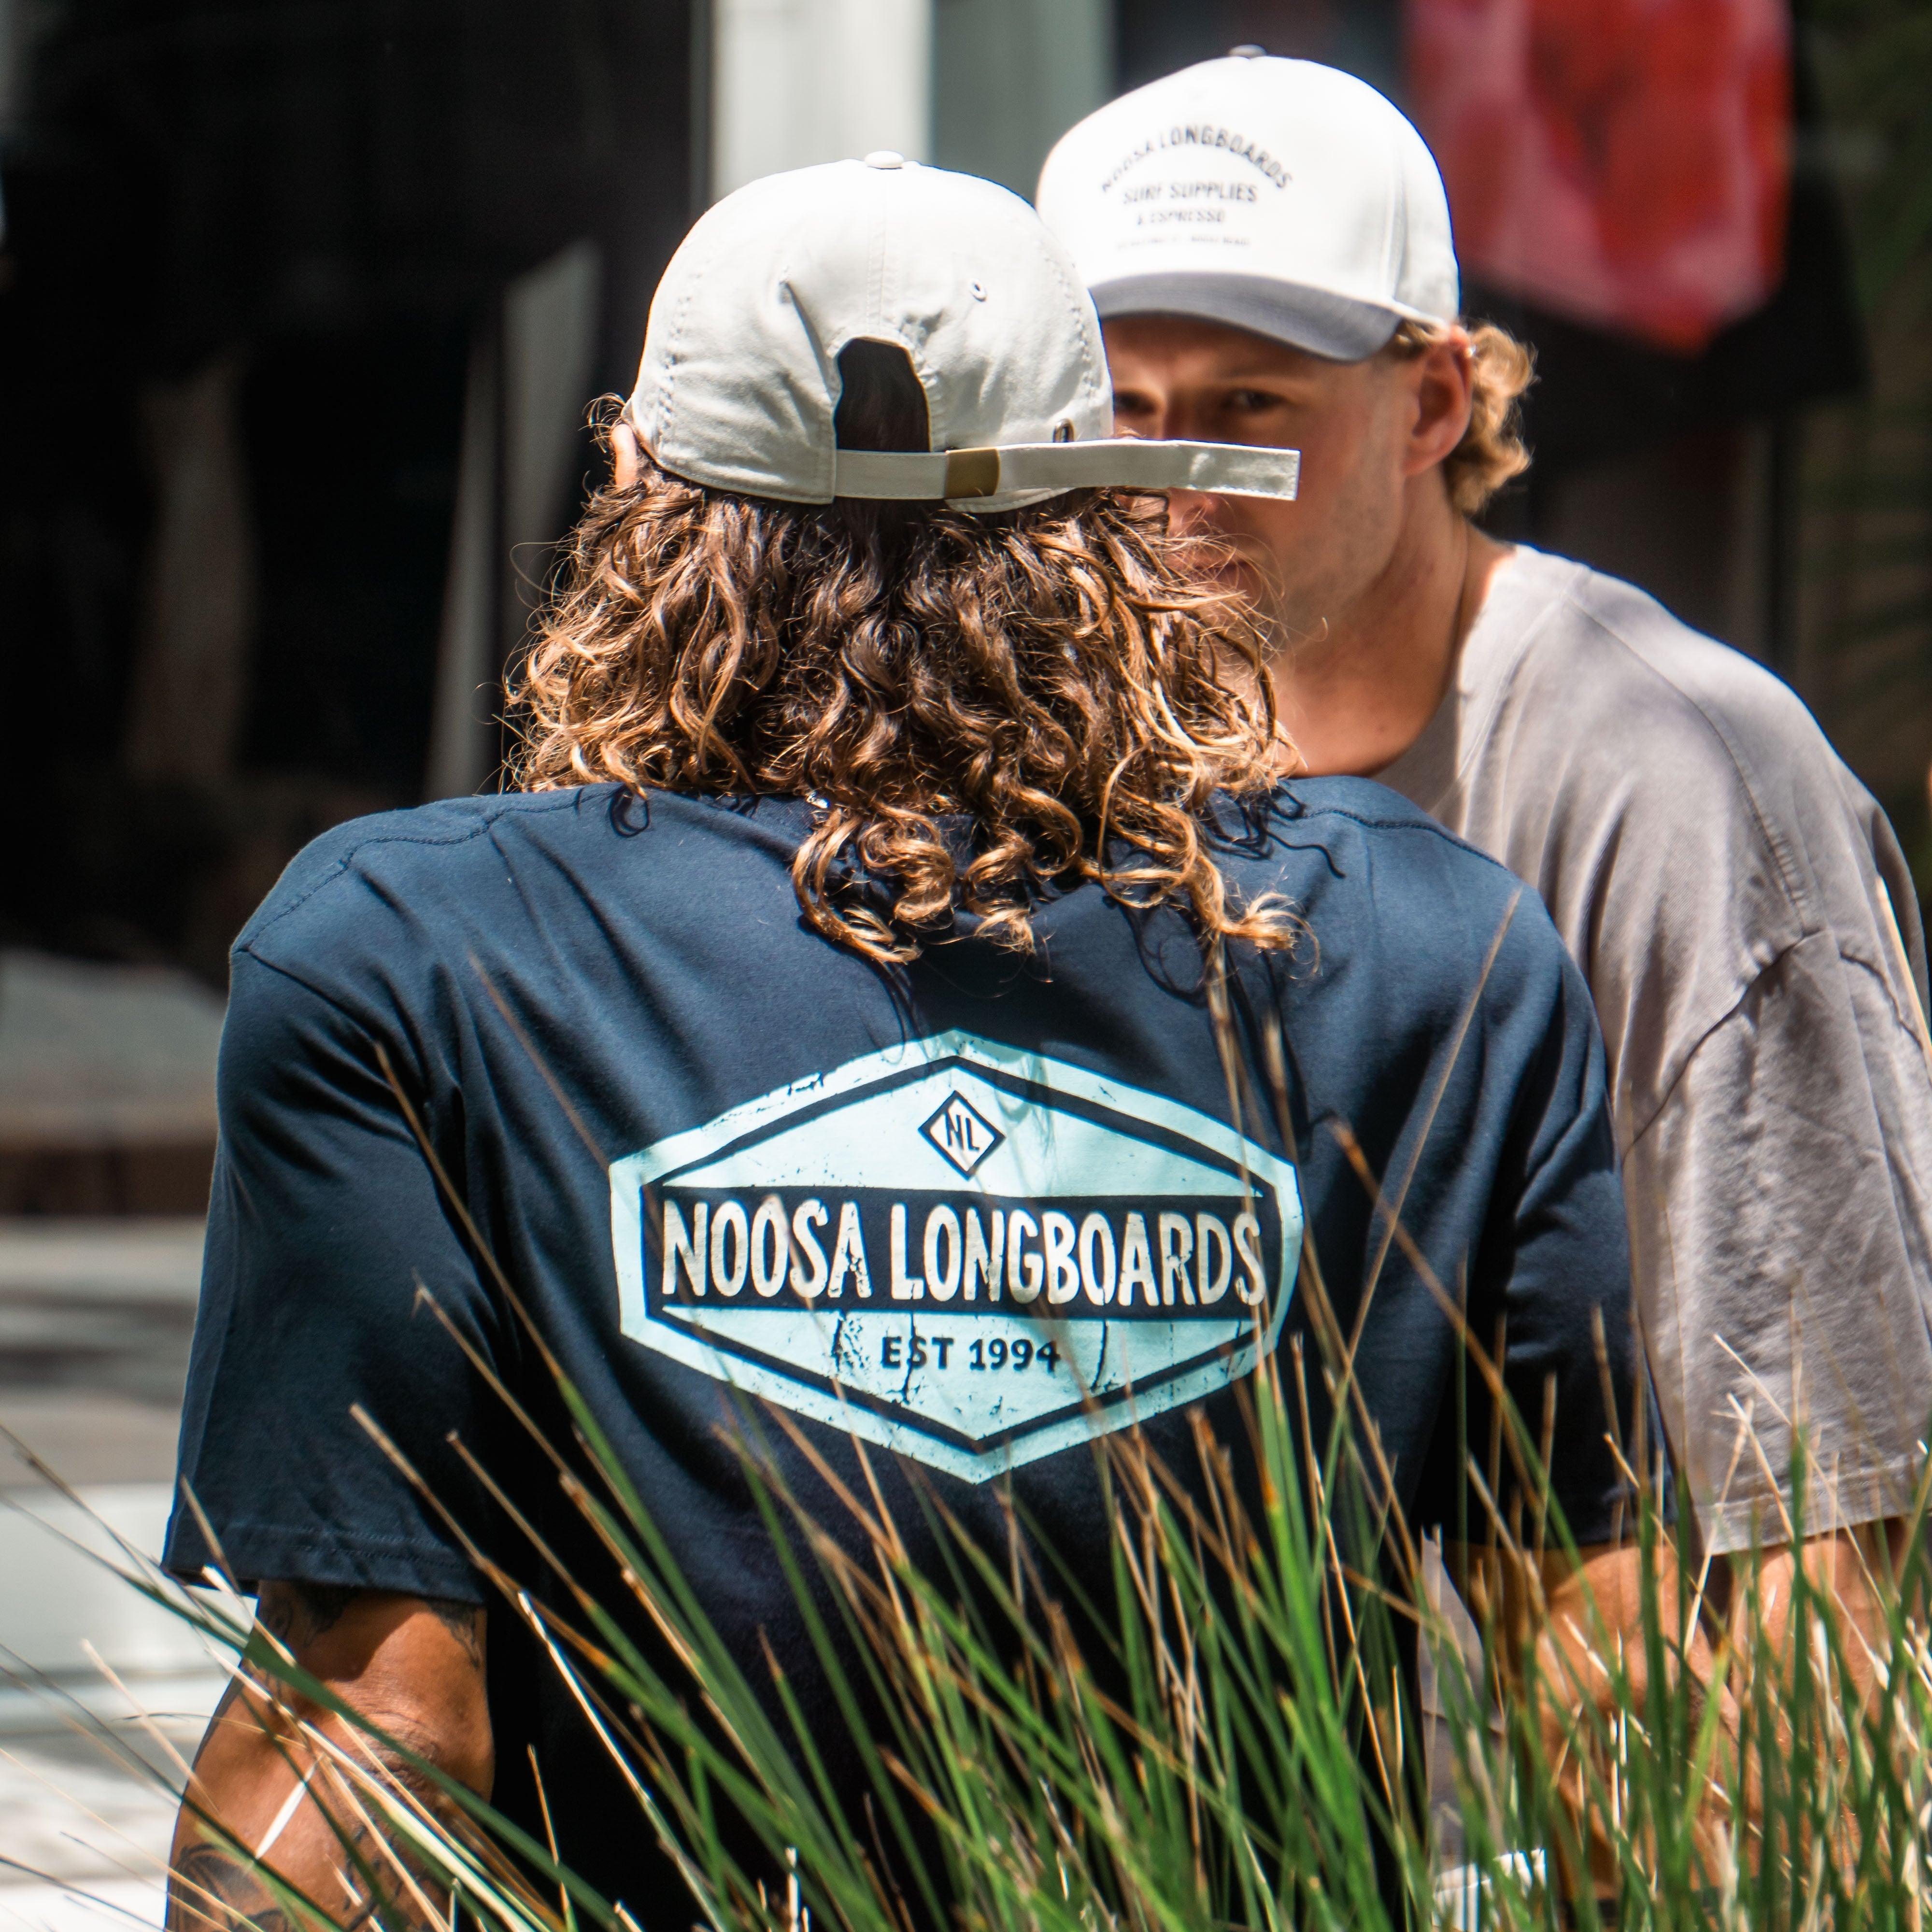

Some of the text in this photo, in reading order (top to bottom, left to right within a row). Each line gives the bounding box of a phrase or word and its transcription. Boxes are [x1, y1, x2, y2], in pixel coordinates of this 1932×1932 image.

[1160, 124, 1293, 189] LONGBOARDS
[1123, 181, 1258, 204] SURF SUPPLIES
[944, 1112, 980, 1152] NL
[662, 1197, 1266, 1306] NOOSA LONGBOARDS
[881, 1335, 1061, 1373] EST 1994
